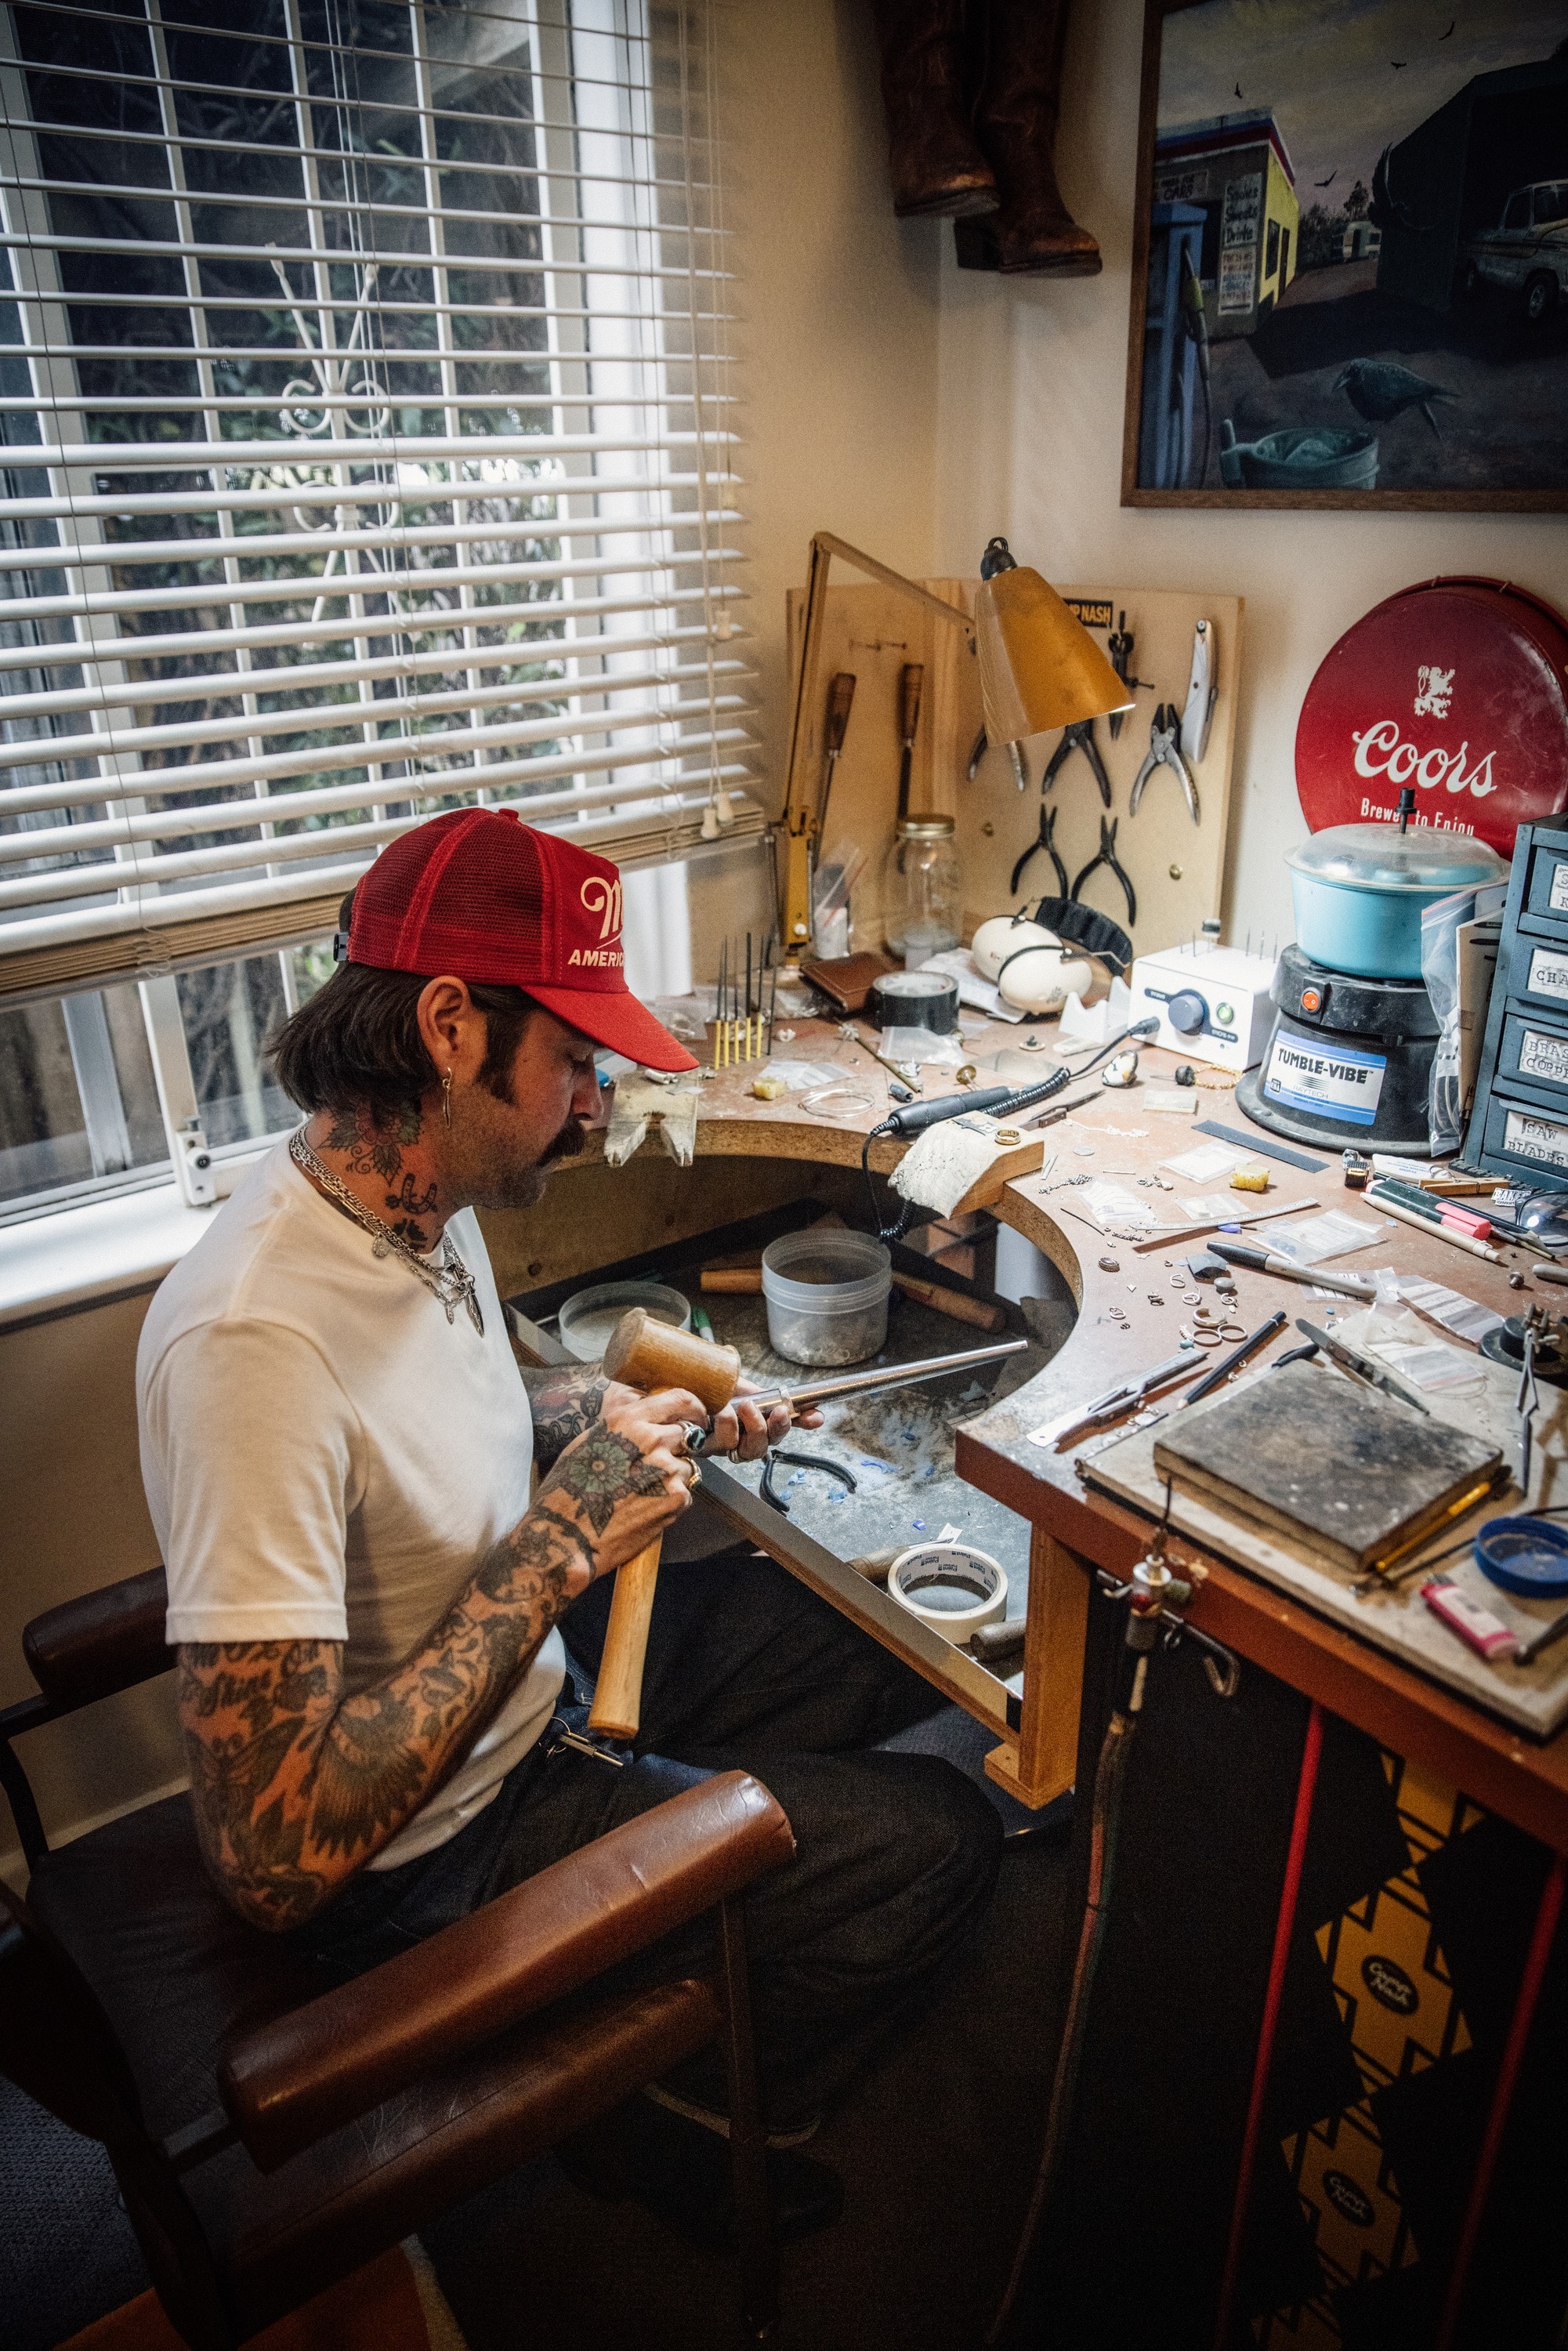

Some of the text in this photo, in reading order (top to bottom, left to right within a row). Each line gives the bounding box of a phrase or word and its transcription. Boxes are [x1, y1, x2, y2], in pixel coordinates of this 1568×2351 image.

[1081, 604, 1111, 624] NASH
[1352, 720, 1497, 797] Coors
[1360, 797, 1400, 824] Brewe
[1527, 1123, 1559, 1140] SAW
[1508, 1140, 1564, 1166] BLADES
